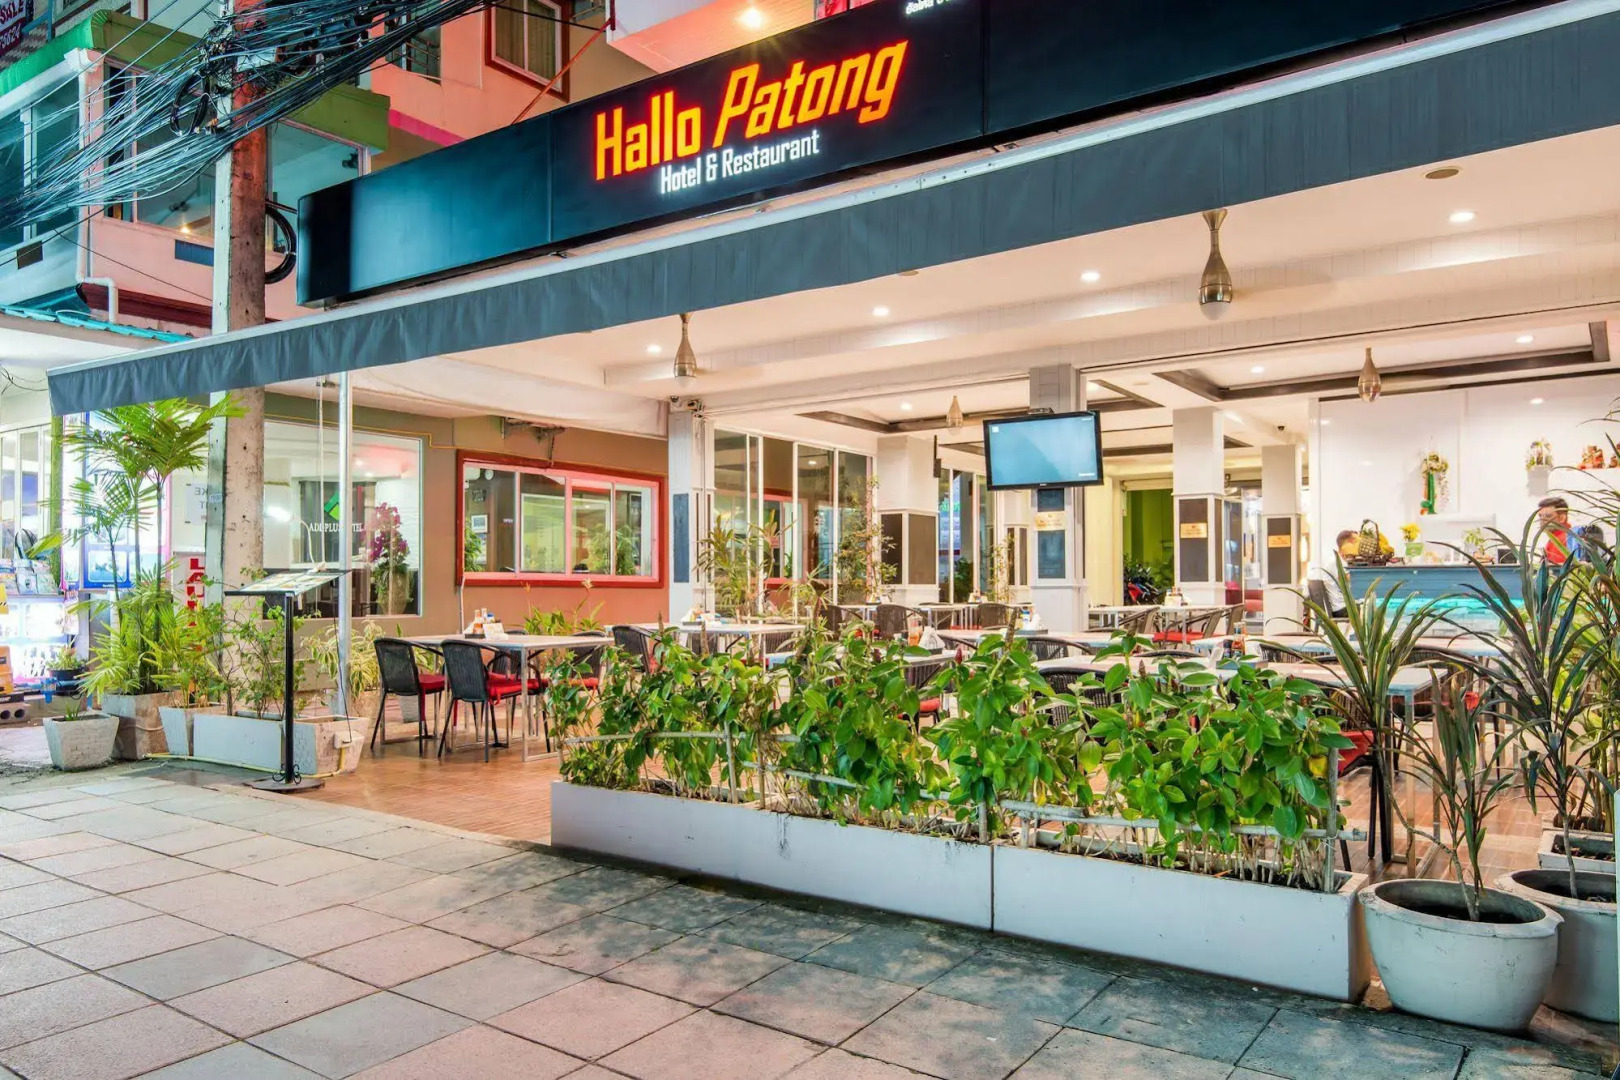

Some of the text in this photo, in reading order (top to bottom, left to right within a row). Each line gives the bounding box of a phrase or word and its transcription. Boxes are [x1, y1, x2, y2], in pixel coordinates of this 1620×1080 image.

[596, 40, 909, 181] Hallo Patong
[660, 129, 820, 194] Hotel & Restaurant
